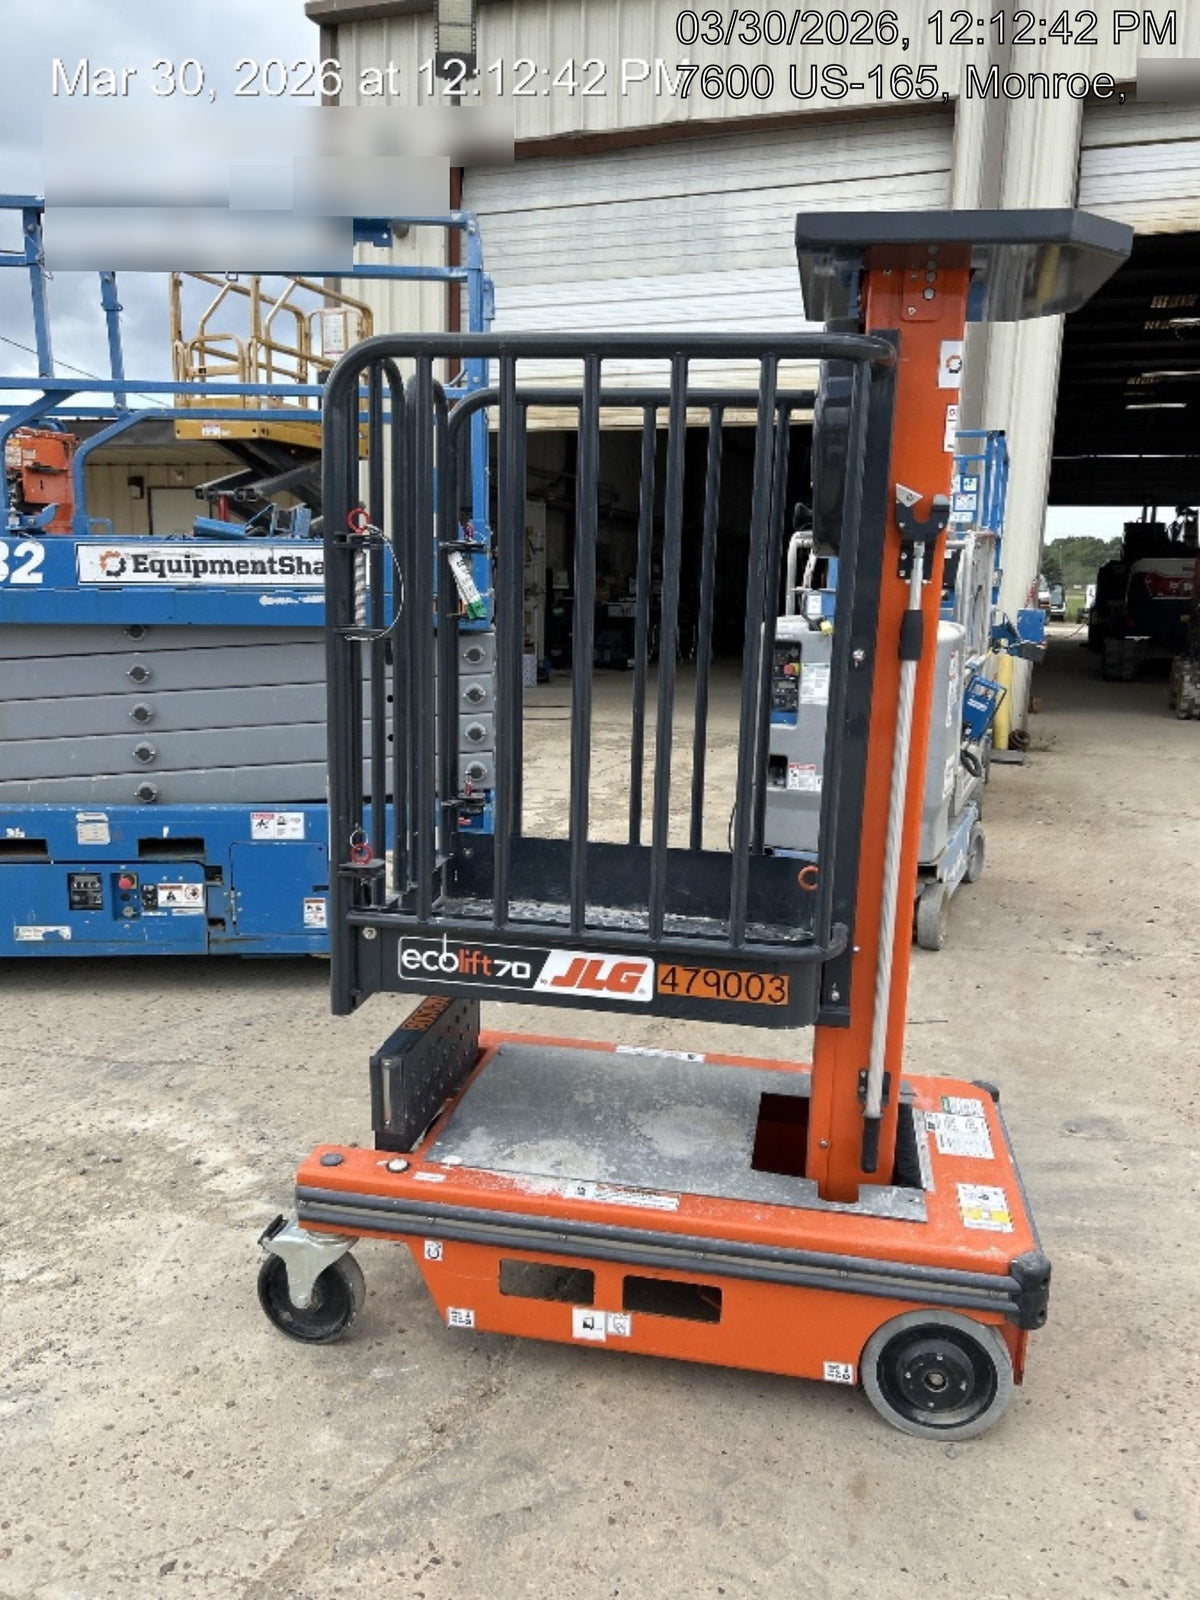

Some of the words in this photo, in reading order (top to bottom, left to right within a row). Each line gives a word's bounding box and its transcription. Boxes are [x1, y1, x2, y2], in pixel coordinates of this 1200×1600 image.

[132, 555, 325, 578] EquipmentSha
[550, 957, 648, 994] JLG
[660, 966, 787, 1004] 479003
